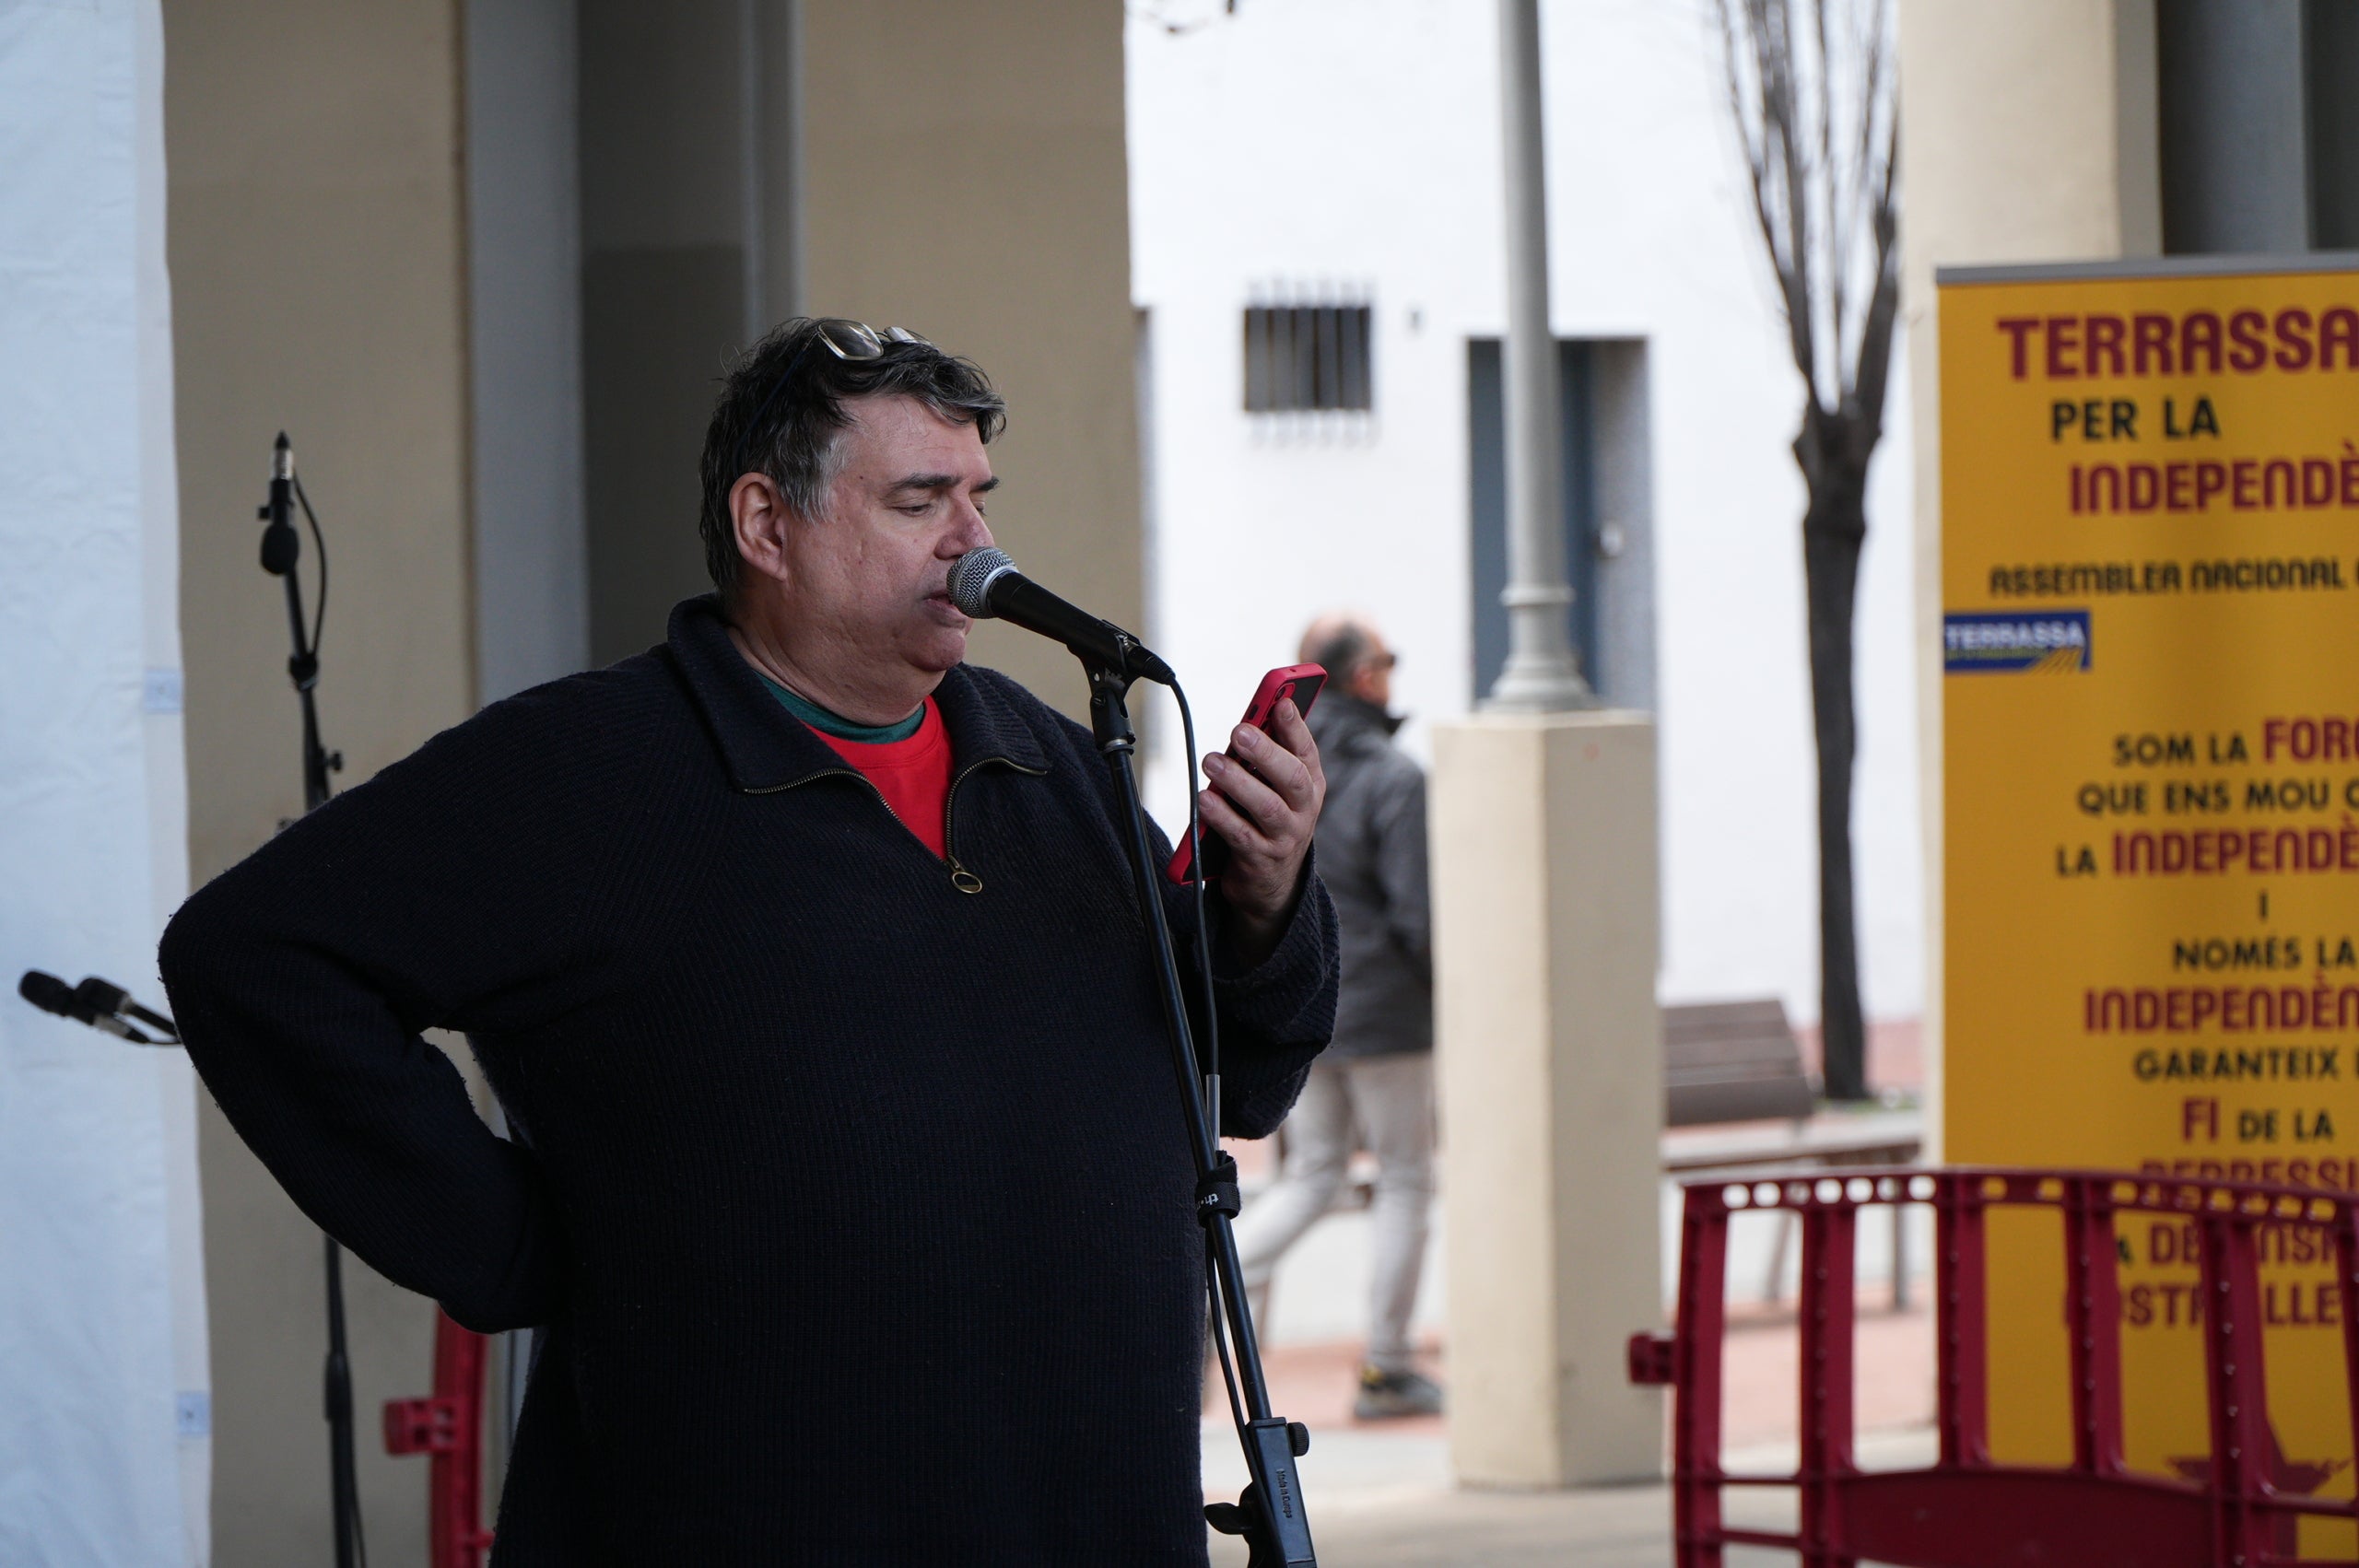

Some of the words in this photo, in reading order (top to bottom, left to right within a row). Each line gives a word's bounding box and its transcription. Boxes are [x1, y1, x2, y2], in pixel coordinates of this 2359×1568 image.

[1997, 306, 2359, 380] TERRASSA
[2051, 399, 2138, 442] PER
[2164, 395, 2220, 439] LA
[2190, 557, 2346, 591] NACIONAL
[1945, 622, 2085, 649] TERRASSA
[2113, 733, 2196, 766] SOM
[2209, 732, 2248, 764] LA
[2264, 717, 2359, 763] FOR
[2077, 782, 2148, 816] QUE
[2164, 780, 2230, 813] ENS
[2245, 779, 2330, 811] MOU
[2057, 845, 2097, 878] LA
[2259, 889, 2269, 921] I
[2318, 936, 2355, 968] LA
[2134, 1048, 2339, 1082] GARANTEIX
[2182, 1097, 2219, 1141] FI
[2239, 1110, 2278, 1141] DE
[2294, 1109, 2333, 1140] LA
